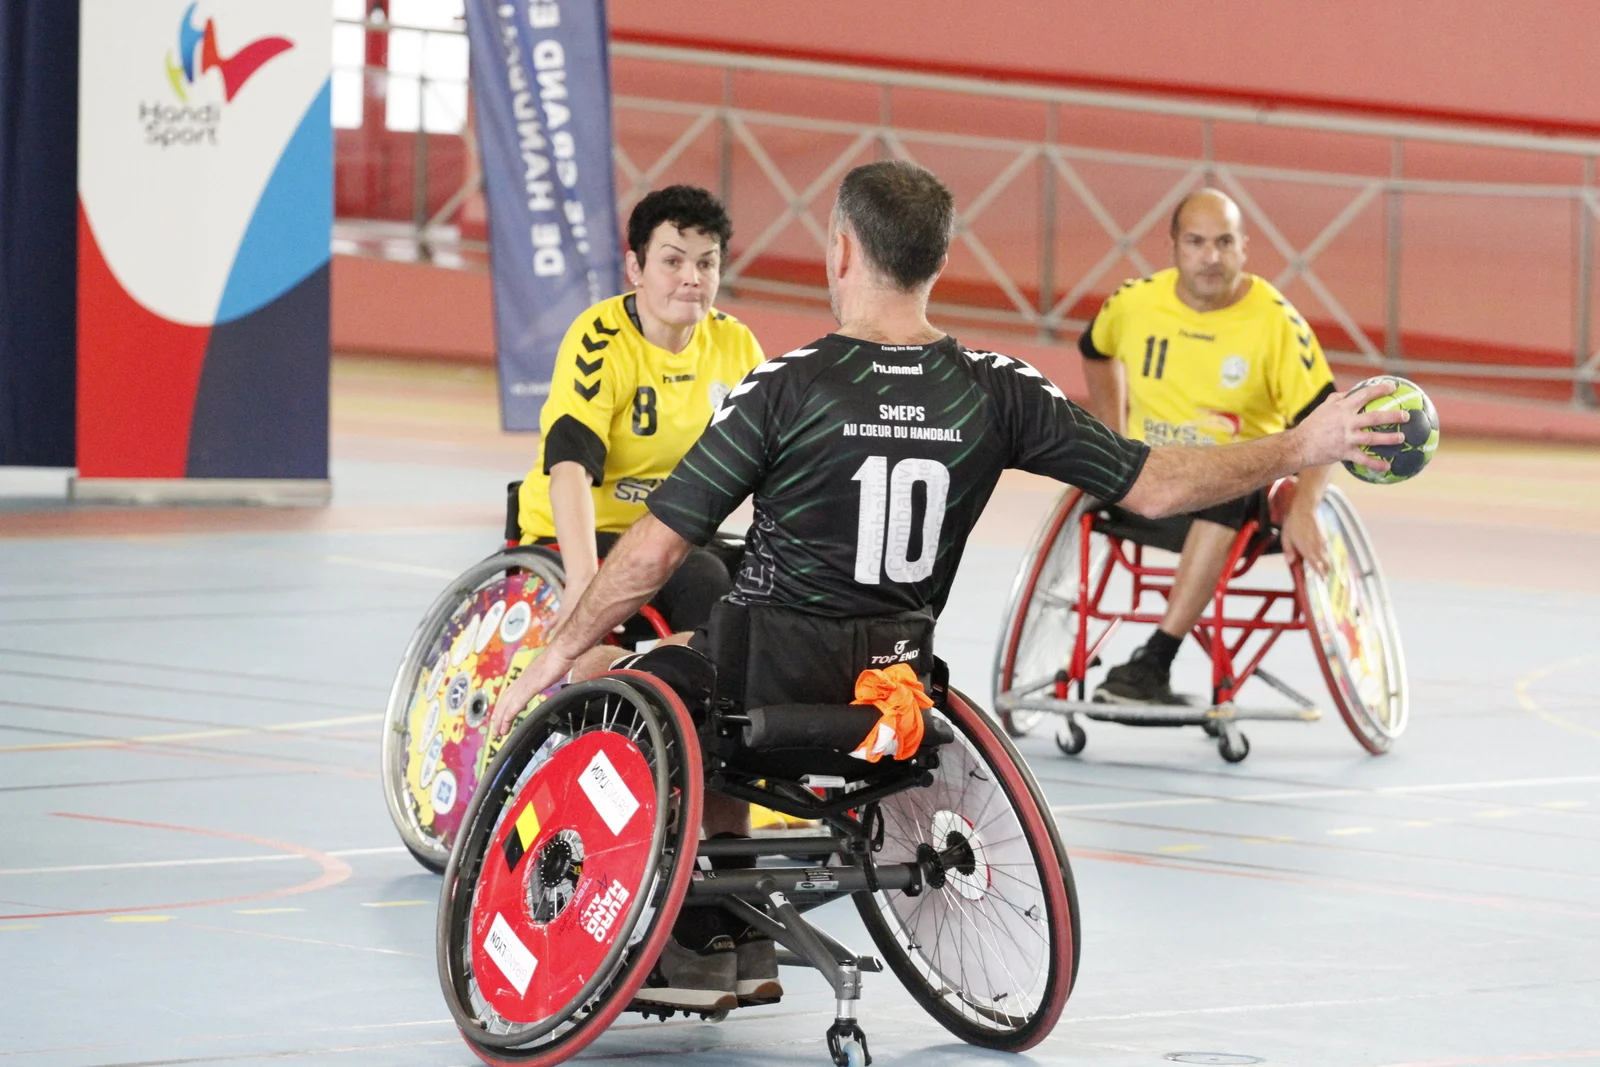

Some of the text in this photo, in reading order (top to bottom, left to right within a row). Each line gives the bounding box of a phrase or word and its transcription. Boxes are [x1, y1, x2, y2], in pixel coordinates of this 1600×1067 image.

[138, 100, 221, 124] Handi
[145, 120, 219, 150] Sport
[872, 361, 923, 375] hummel
[1142, 334, 1169, 380] 11
[631, 386, 657, 436] 8
[879, 404, 926, 422] SMEPS
[843, 423, 963, 442] AU COEUR DU HANDBALL
[852, 455, 950, 585] 10
[871, 650, 919, 664] TOP END
[583, 892, 601, 918] ALL
[586, 879, 622, 935] HAND
[594, 886, 630, 943] EURO
